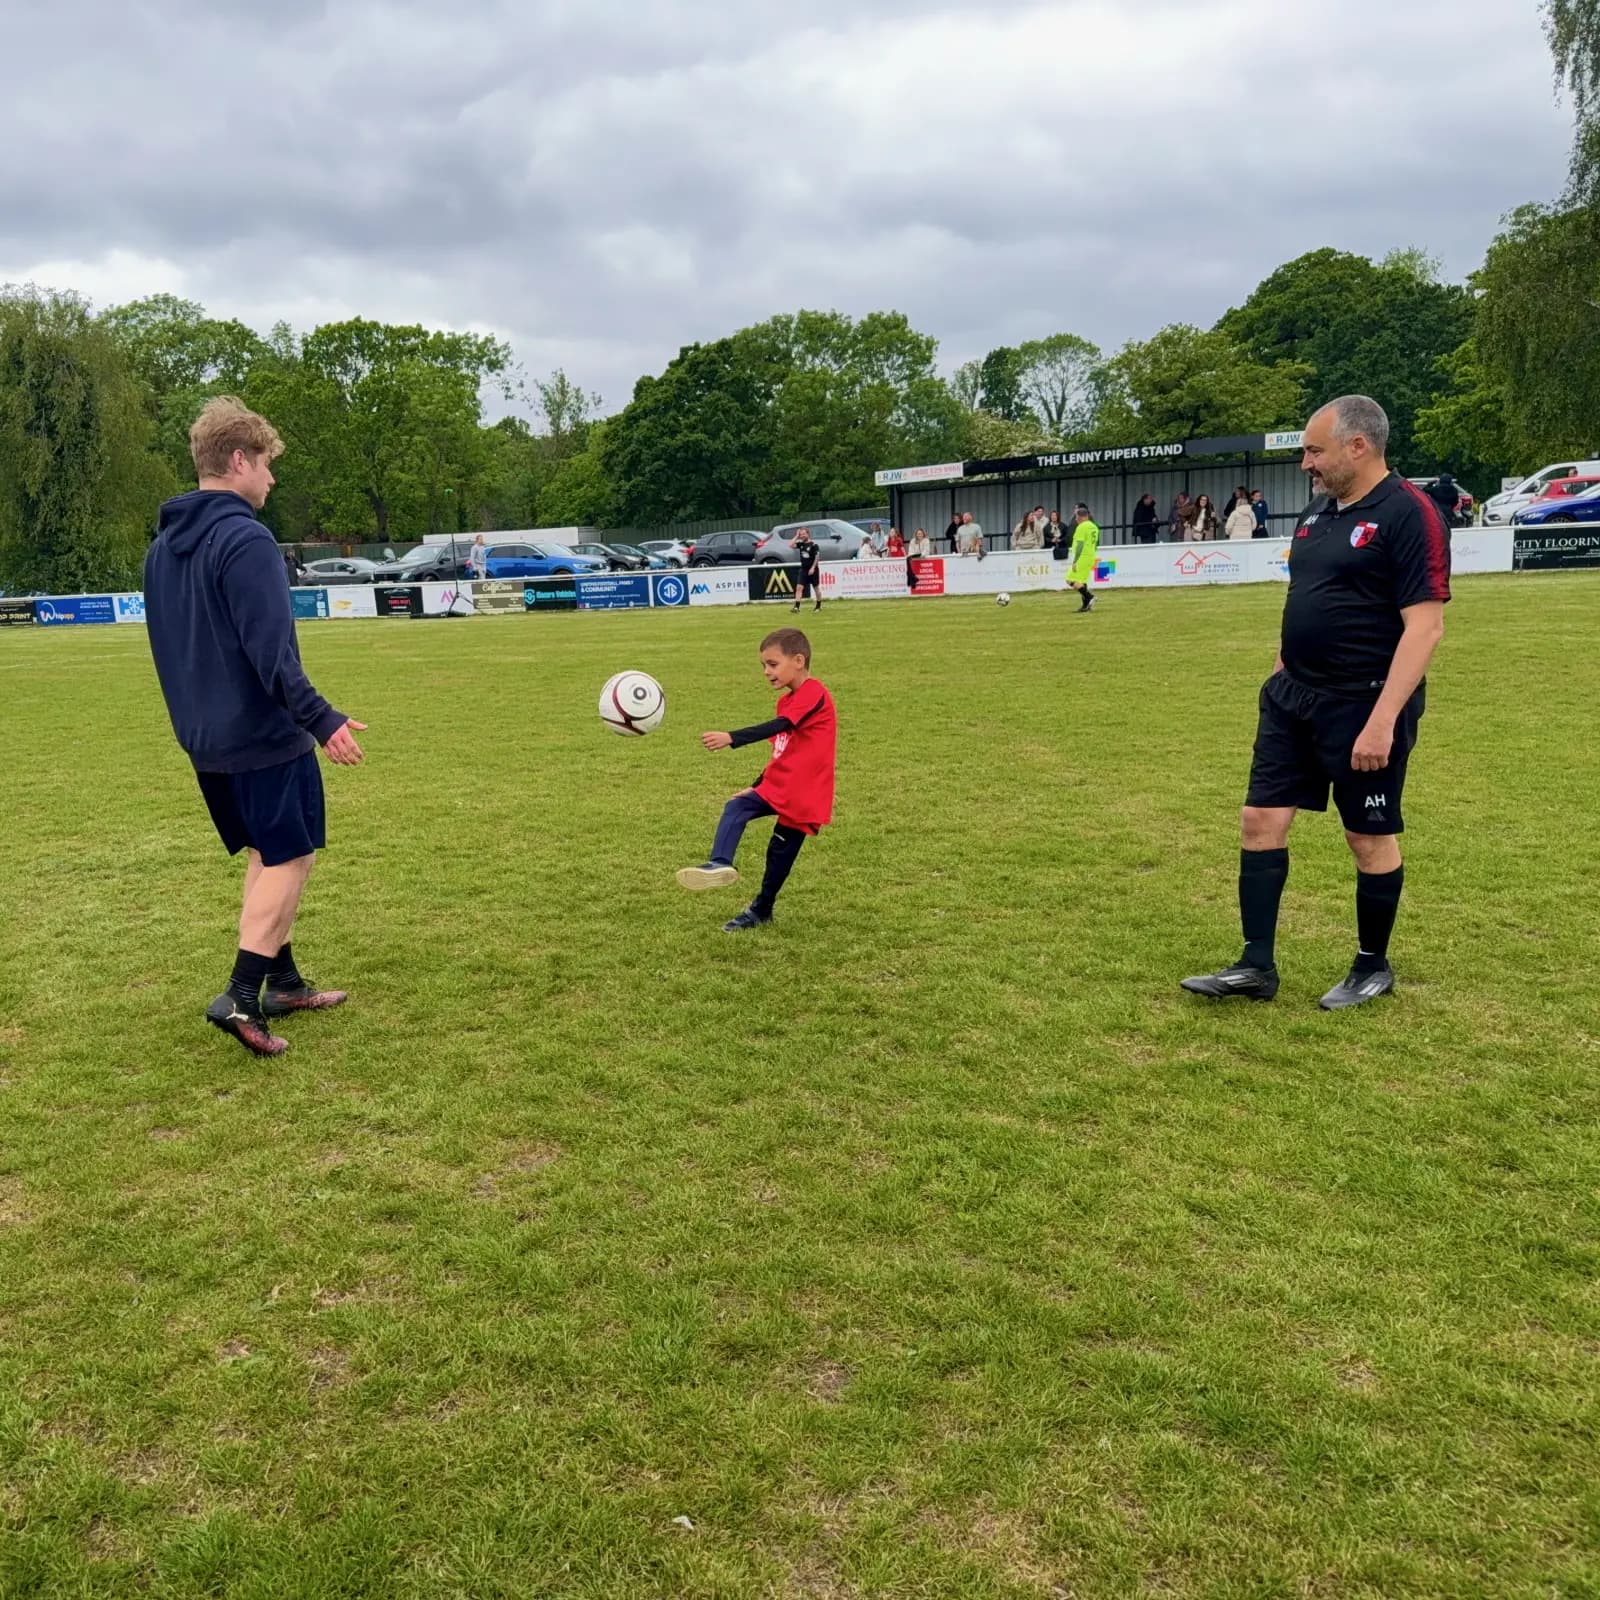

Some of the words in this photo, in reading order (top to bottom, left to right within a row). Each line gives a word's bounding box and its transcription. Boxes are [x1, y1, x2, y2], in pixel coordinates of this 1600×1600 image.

[1276, 433, 1300, 444] RJW
[1037, 455, 1060, 467] THE
[1062, 452, 1101, 465] LENNY
[1104, 448, 1139, 461] PIPER
[1141, 444, 1183, 458] STAND
[1514, 539, 1542, 548] CITY
[715, 580, 747, 590] ASPIRE
[1364, 793, 1386, 808] AH
